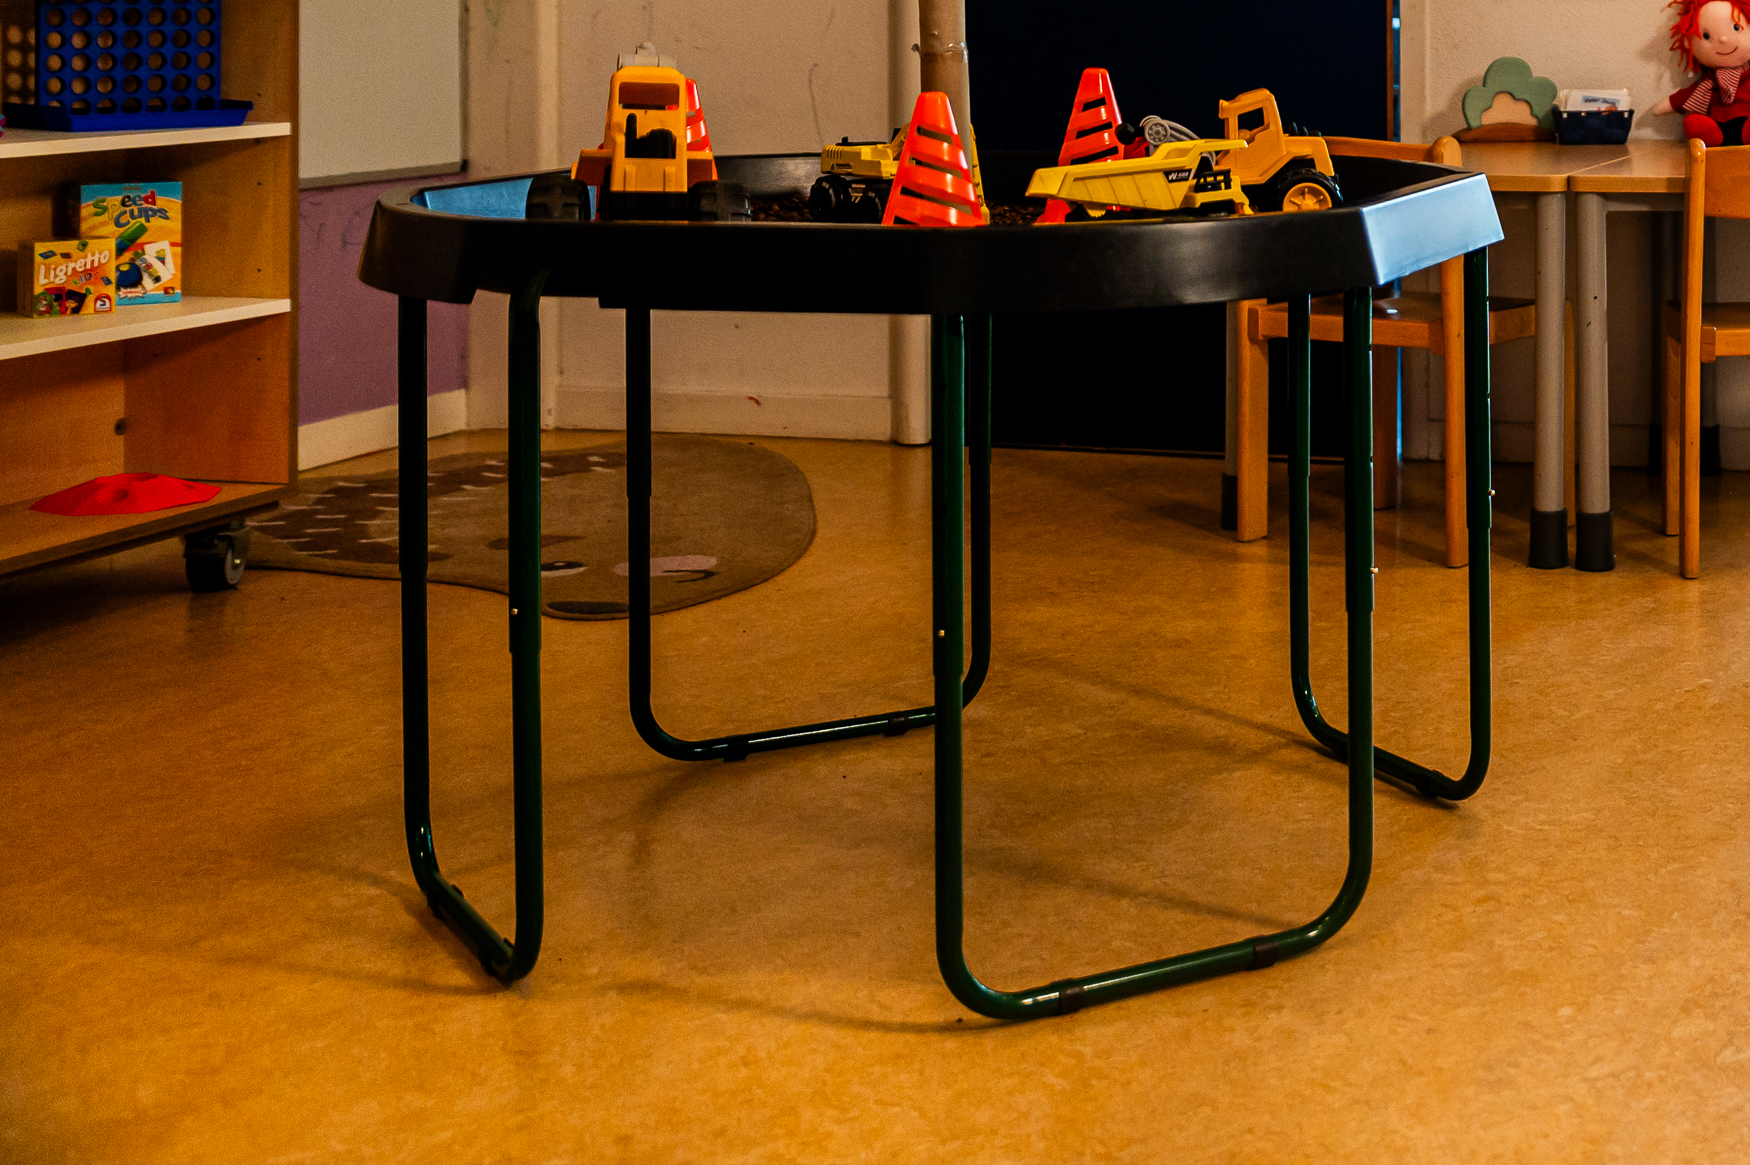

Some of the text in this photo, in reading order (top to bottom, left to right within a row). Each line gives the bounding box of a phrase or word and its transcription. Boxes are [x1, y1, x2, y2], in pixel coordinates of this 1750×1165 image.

[92, 189, 157, 220] Speed
[114, 206, 170, 228] Cups
[39, 250, 110, 285] Ligretto
